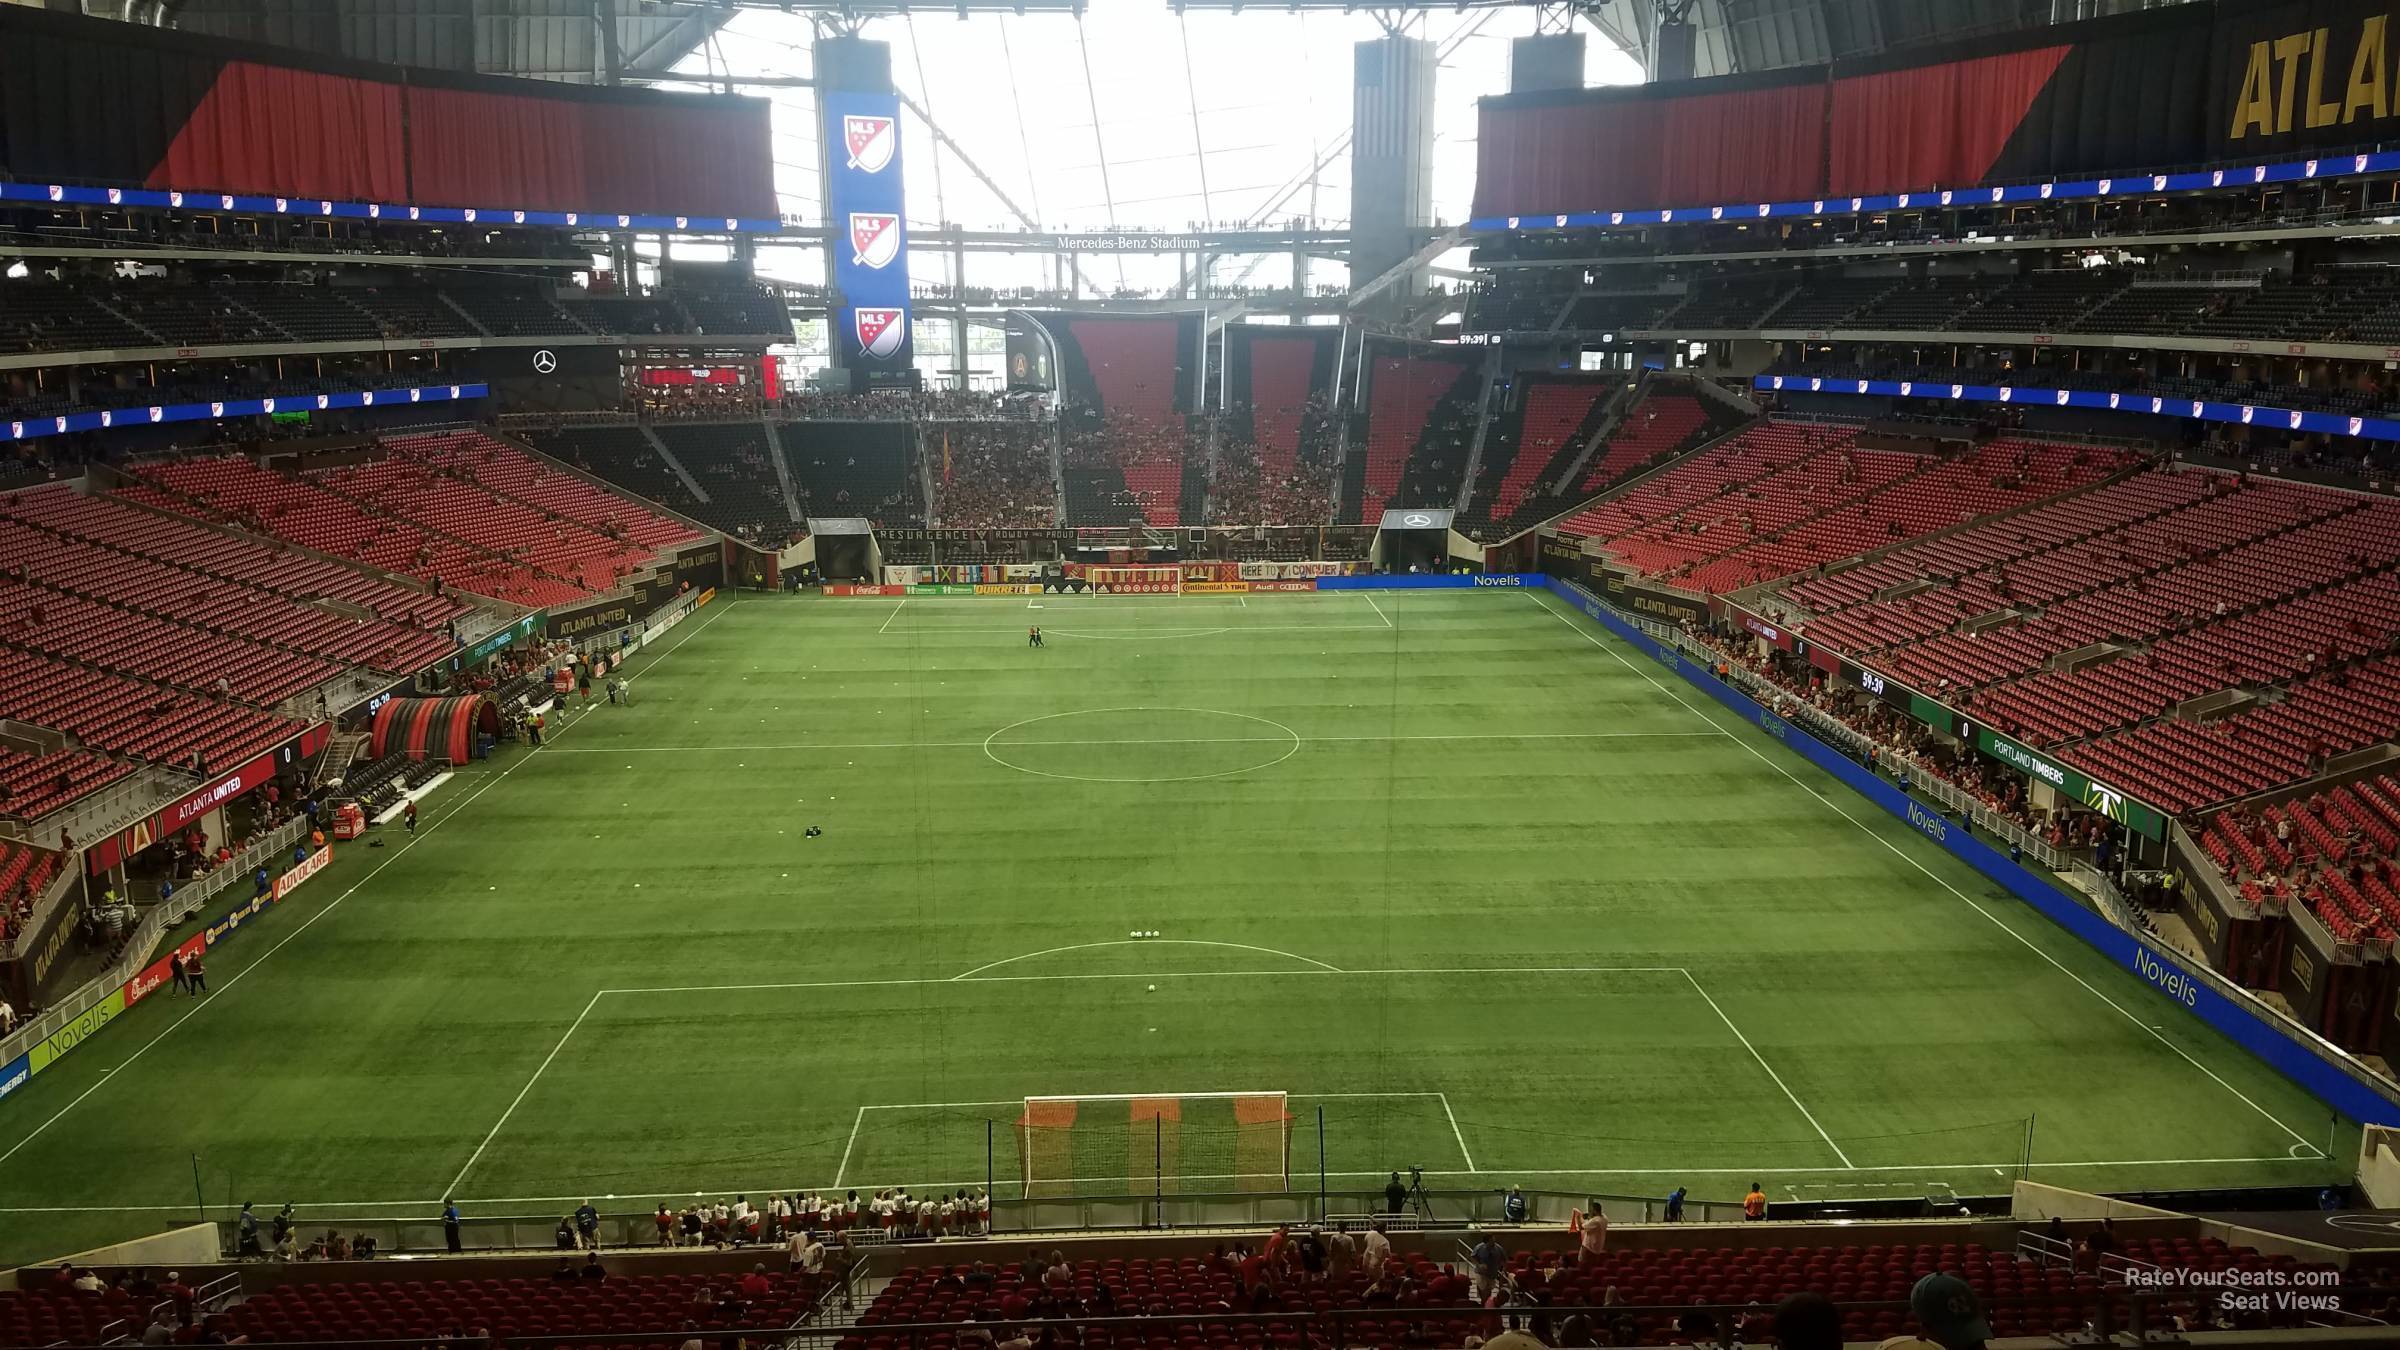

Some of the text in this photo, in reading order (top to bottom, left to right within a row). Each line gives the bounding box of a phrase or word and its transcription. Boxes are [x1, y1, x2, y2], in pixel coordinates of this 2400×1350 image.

[2230, 14, 2400, 139] ATLA
[849, 120, 876, 134] MLS
[856, 218, 881, 231] MLS
[1057, 237, 1200, 249] Mercedes-Benz Stadium
[861, 314, 886, 326] MLS
[1460, 335, 1483, 345] 59:39
[880, 530, 968, 540] RESURGENCE
[995, 530, 1029, 540] ROWDY
[1046, 530, 1075, 539] PROUD
[1241, 564, 1262, 577] HERE
[1265, 563, 1277, 576] TO
[1182, 582, 1223, 593] Continental
[1474, 575, 1520, 587] Novelis
[975, 584, 1025, 595] QUIKRETE
[1633, 596, 1697, 622] ATLANTA UNITED
[560, 608, 626, 635] ATLANTA UNITED
[1762, 627, 1777, 641] UNITED
[1798, 641, 1803, 655] 0
[1862, 671, 1884, 695] 59:39
[1760, 710, 1785, 738] Novelis
[1963, 722, 1969, 737] 0
[284, 747, 291, 763] 0
[1994, 739, 2065, 785] PORTLAND TIMBERS
[178, 776, 241, 821] ATLANTA UNITED
[1907, 801, 1947, 841] Novelis
[278, 848, 328, 894] ADVOCARE
[2134, 947, 2197, 1007] Novelis
[47, 1005, 109, 1061] Novelis
